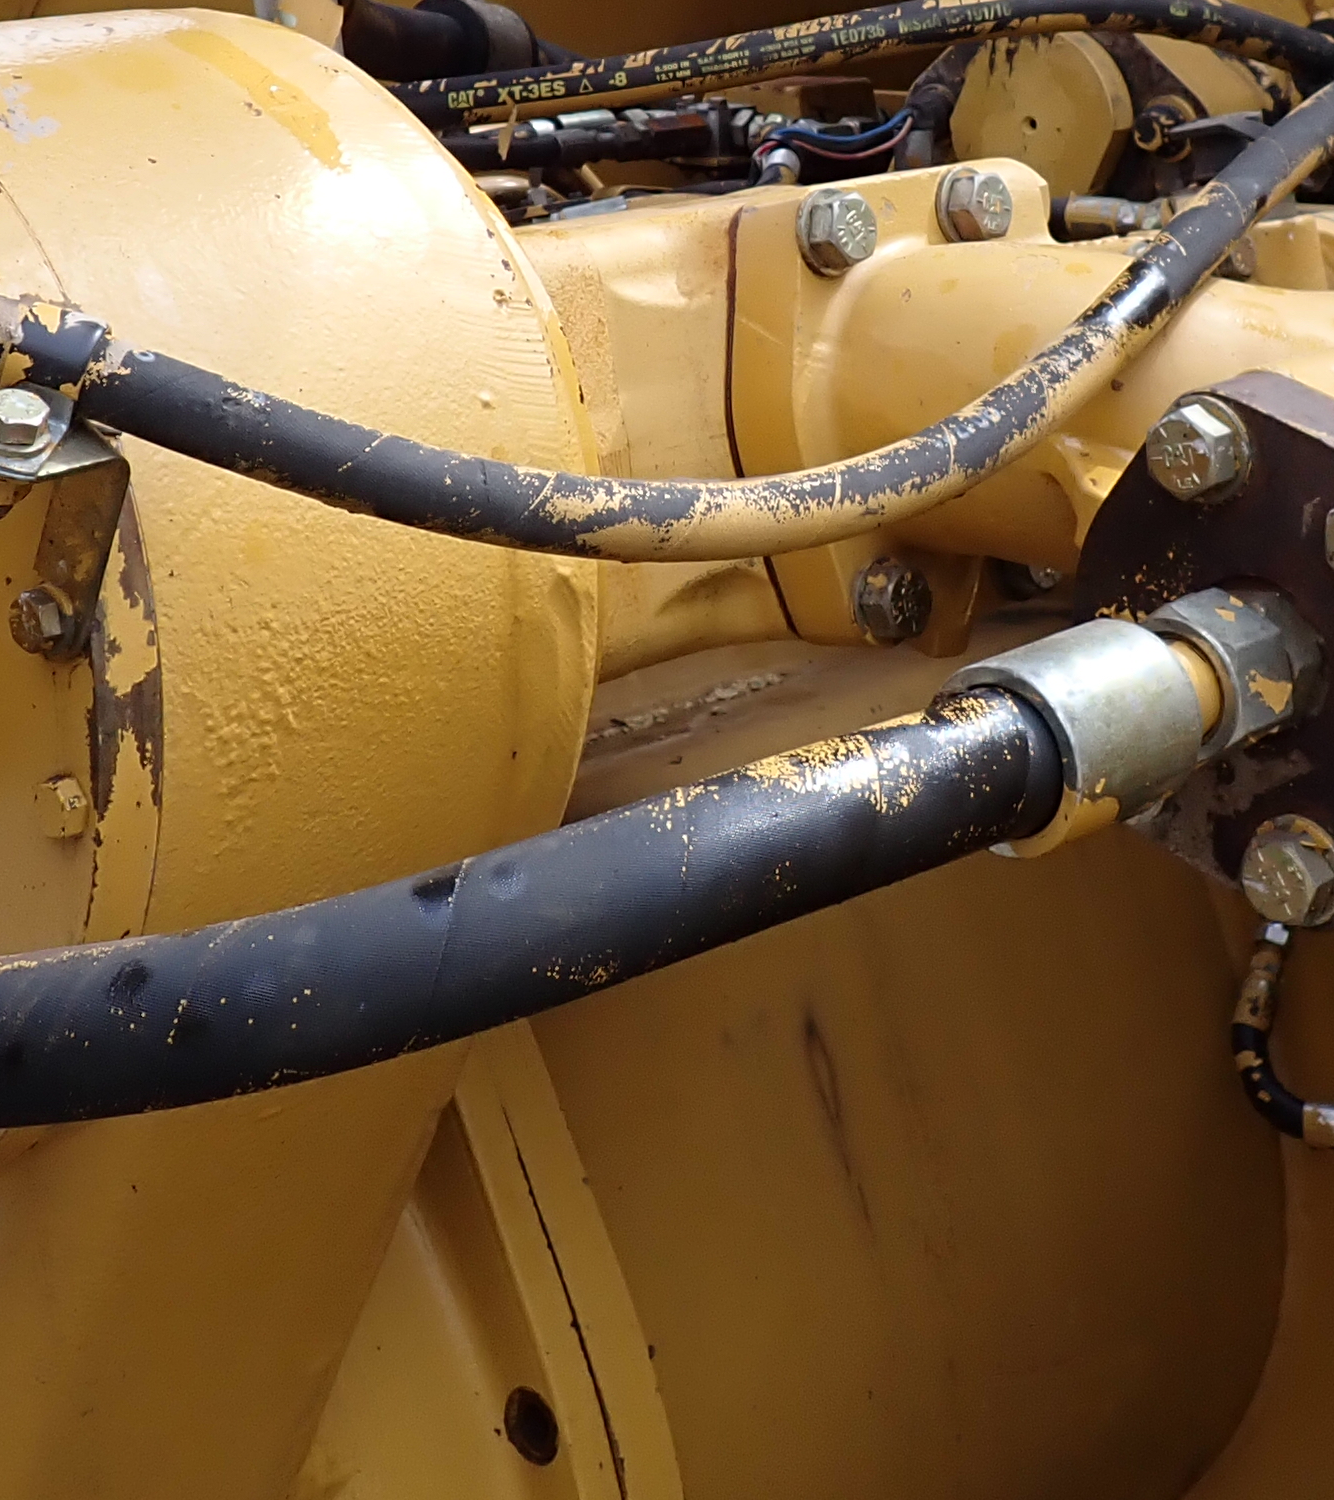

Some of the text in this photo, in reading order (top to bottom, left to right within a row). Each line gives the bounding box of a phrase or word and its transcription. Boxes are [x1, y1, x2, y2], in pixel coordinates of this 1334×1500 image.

[830, 23, 886, 47] 1E0736
[448, 89, 475, 108] CAT
[497, 80, 566, 102] XT-3ES
